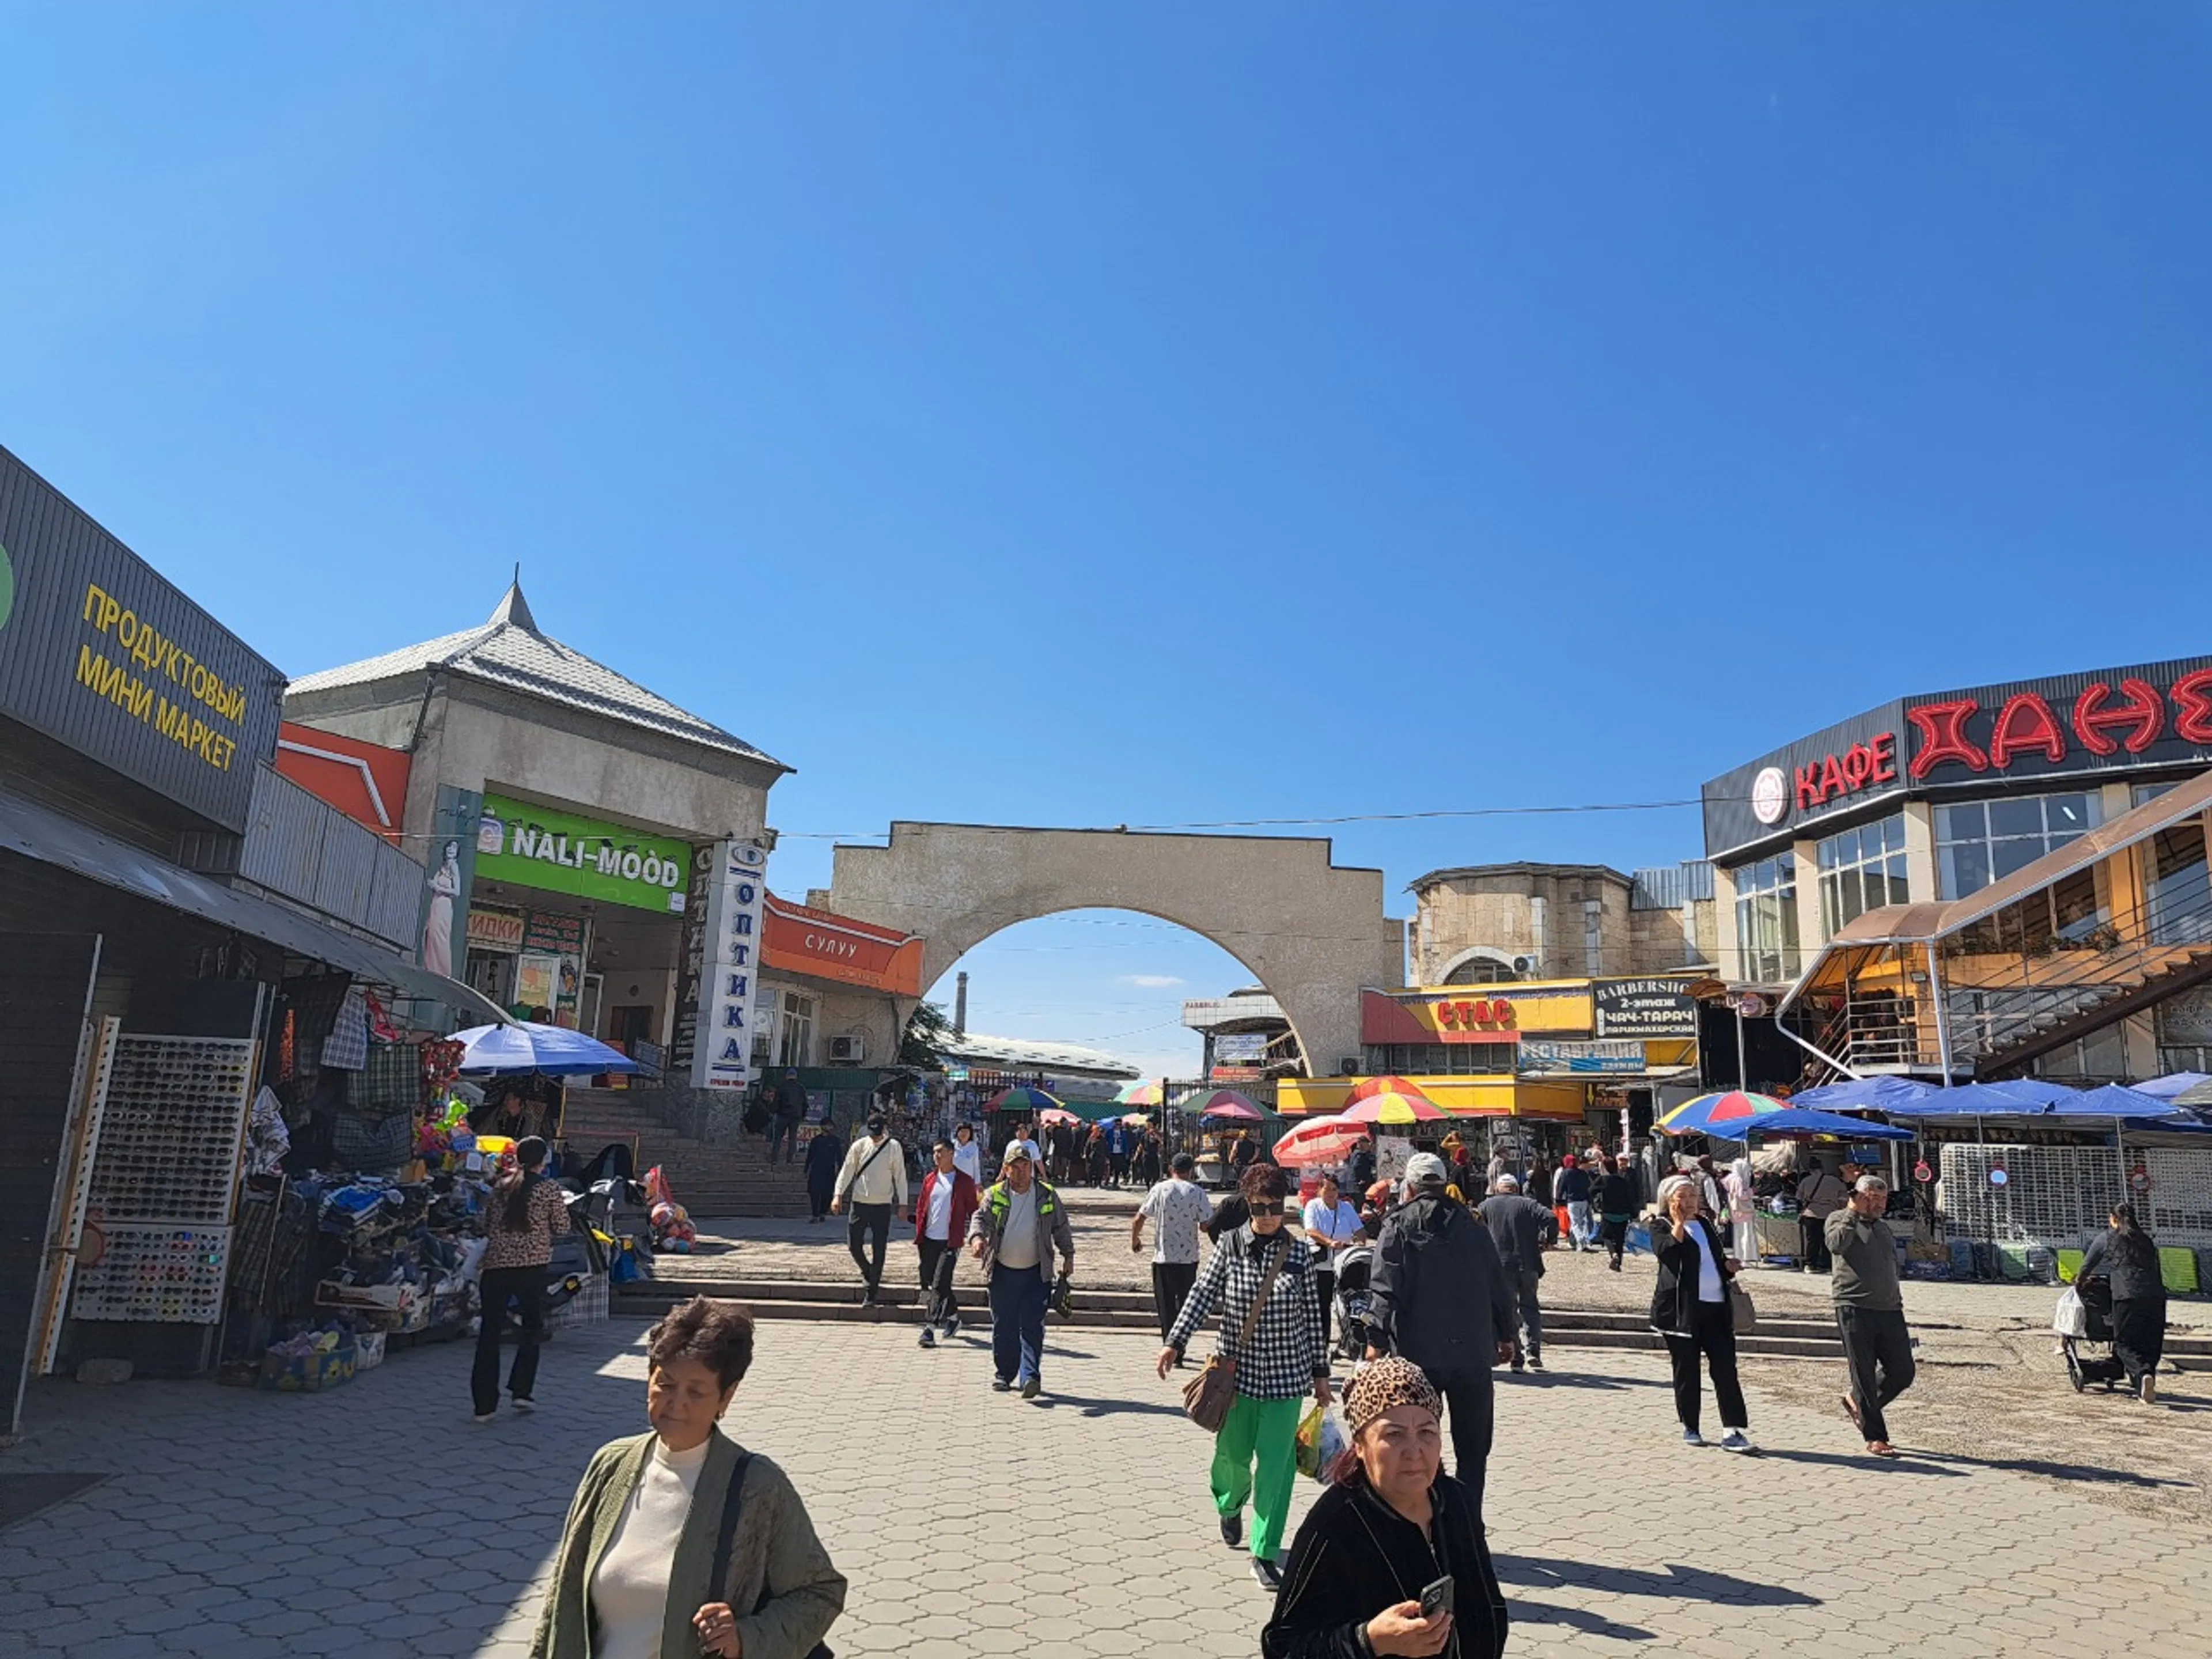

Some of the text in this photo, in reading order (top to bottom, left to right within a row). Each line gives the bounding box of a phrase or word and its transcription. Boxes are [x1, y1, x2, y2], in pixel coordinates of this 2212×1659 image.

[83, 583, 247, 726] ПРОДУКТОВЫЙ
[76, 644, 236, 772] МИНИ МАРКЕТ
[1794, 731, 1895, 809] КАФЕ
[512, 827, 679, 888] NALI-MOOD
[468, 914, 521, 941] ИДКИ
[805, 934, 857, 958] СУЛУУ
[720, 882, 755, 1059] ОПТИКА
[1596, 980, 1690, 1001] BARBERSHO
[1437, 999, 1511, 1024] СТАС
[1605, 1011, 1693, 1022] ЧАЧ-ТАРАЧ
